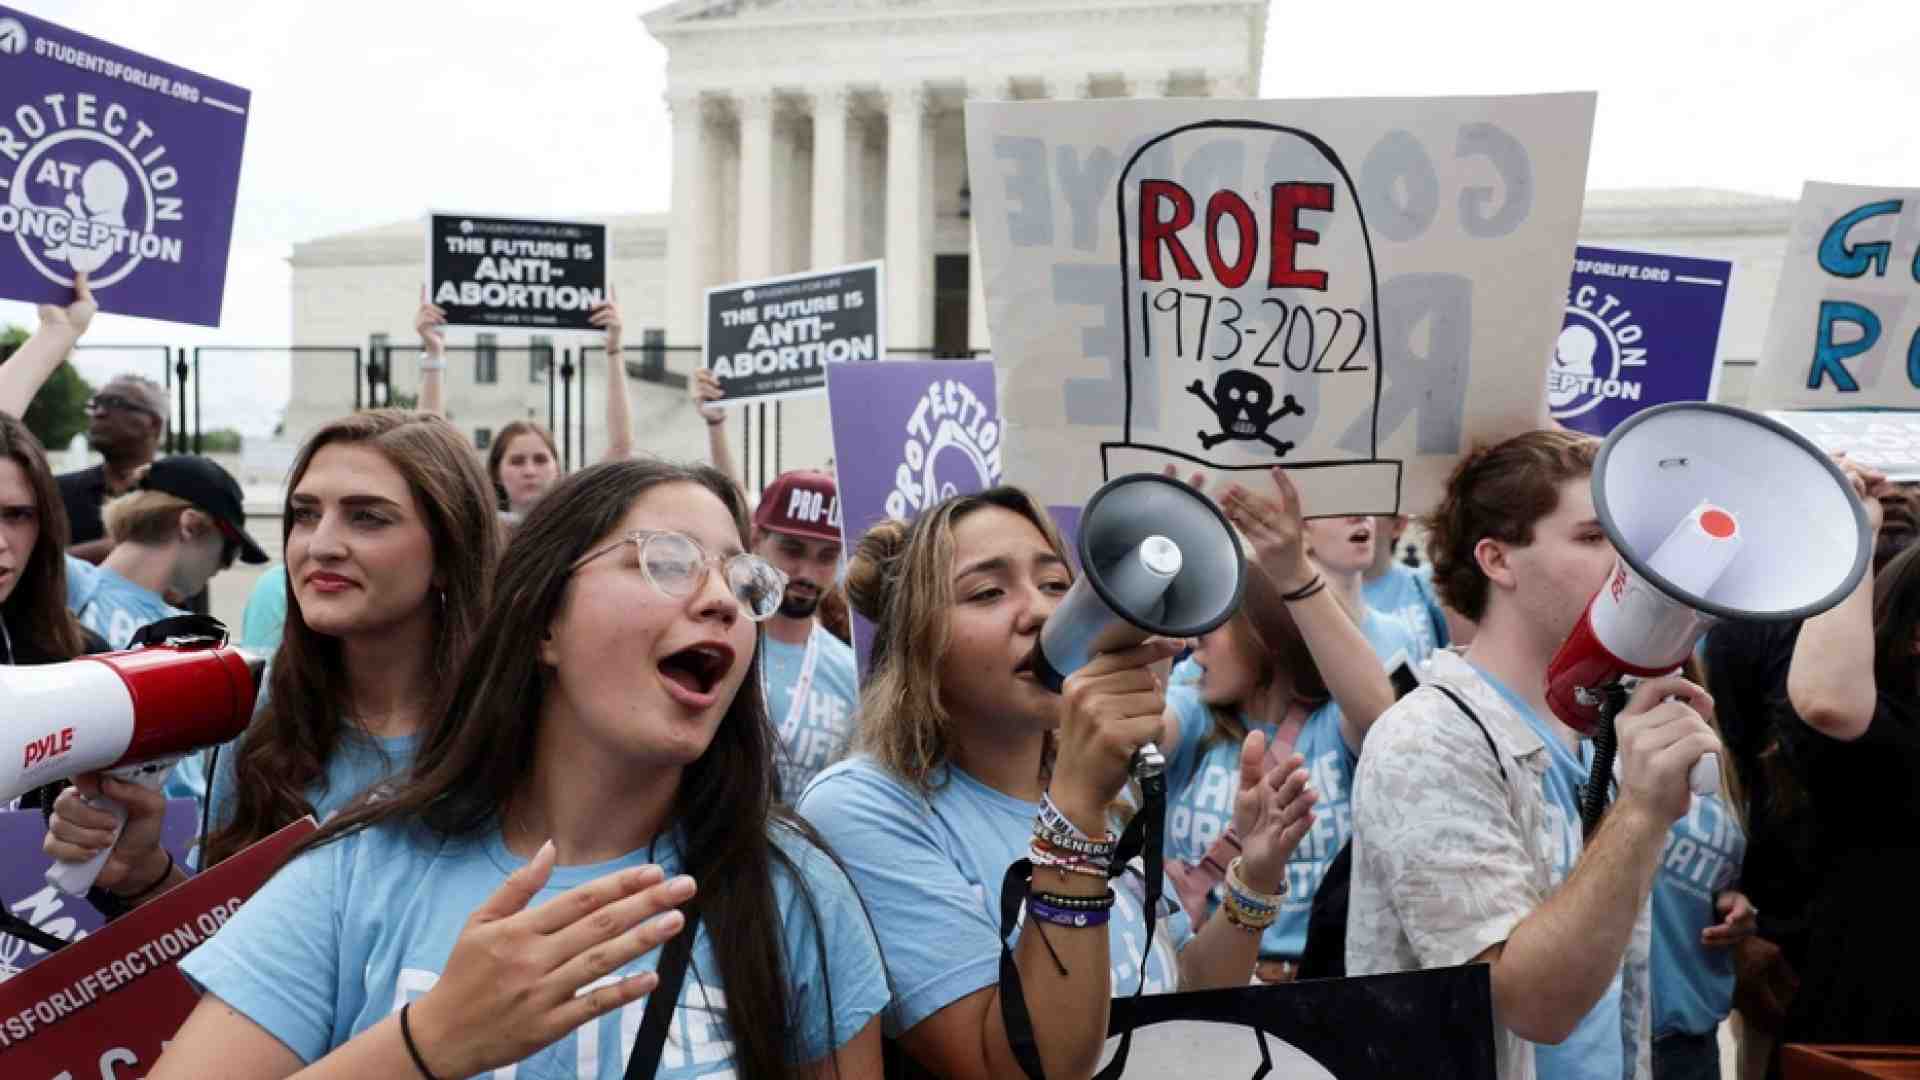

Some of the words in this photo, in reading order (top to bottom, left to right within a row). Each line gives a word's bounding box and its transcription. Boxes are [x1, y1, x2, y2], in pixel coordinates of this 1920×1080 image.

[34, 37, 200, 103] STUDENTSFORLIFE.ORG
[0, 93, 183, 221] ROTECTION
[36, 159, 81, 190] AT
[0, 205, 182, 263] ONCEPTION
[445, 236, 486, 254] THE
[491, 239, 569, 259] FUTURE
[573, 243, 593, 260] IS
[1138, 179, 1335, 293] ROE
[1818, 199, 1920, 285] G
[474, 256, 565, 283] ANTI-
[435, 280, 602, 311] ABORTION
[720, 306, 758, 327] THE
[763, 294, 839, 321] FUTURE
[844, 290, 864, 309] IS
[747, 316, 836, 350] ANTI-
[1140, 287, 1370, 374] 1973-2022
[1567, 285, 1648, 368] CTION
[1806, 300, 1920, 392] R
[711, 334, 874, 379] ABORTION
[1548, 370, 1642, 401] EPTION
[885, 379, 1003, 519] PROTECTION
[786, 487, 840, 528] PRO-L
[23, 726, 74, 768] PYLE
